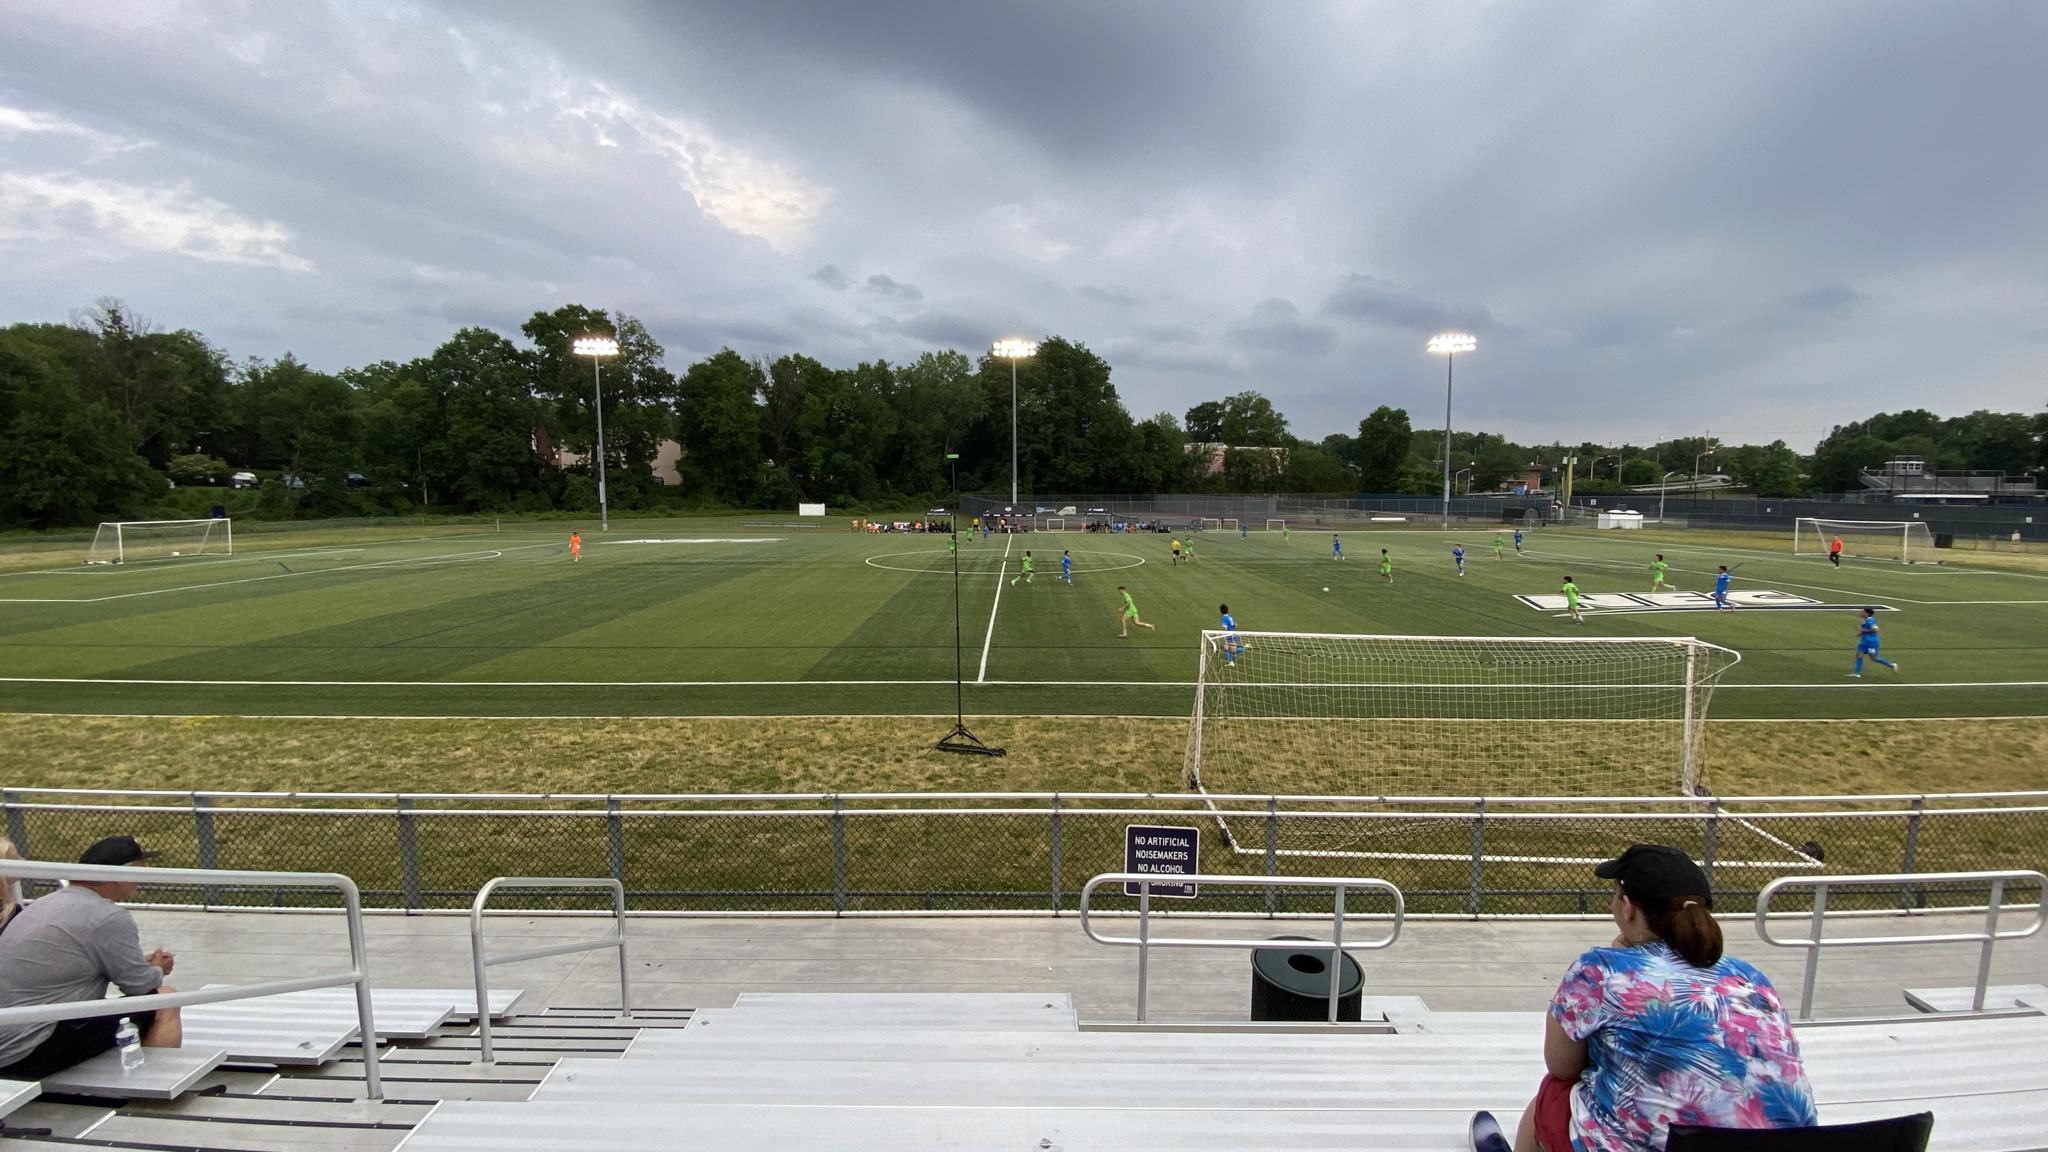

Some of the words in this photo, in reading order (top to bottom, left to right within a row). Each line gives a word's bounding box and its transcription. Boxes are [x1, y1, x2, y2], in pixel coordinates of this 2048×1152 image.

[1134, 836, 1146, 845] NO
[1147, 837, 1190, 847] ARTIFICIAL
[1135, 850, 1188, 860] NOISEMAKERS
[1137, 864, 1148, 872] NO
[1150, 864, 1185, 874] ALCOHOL
